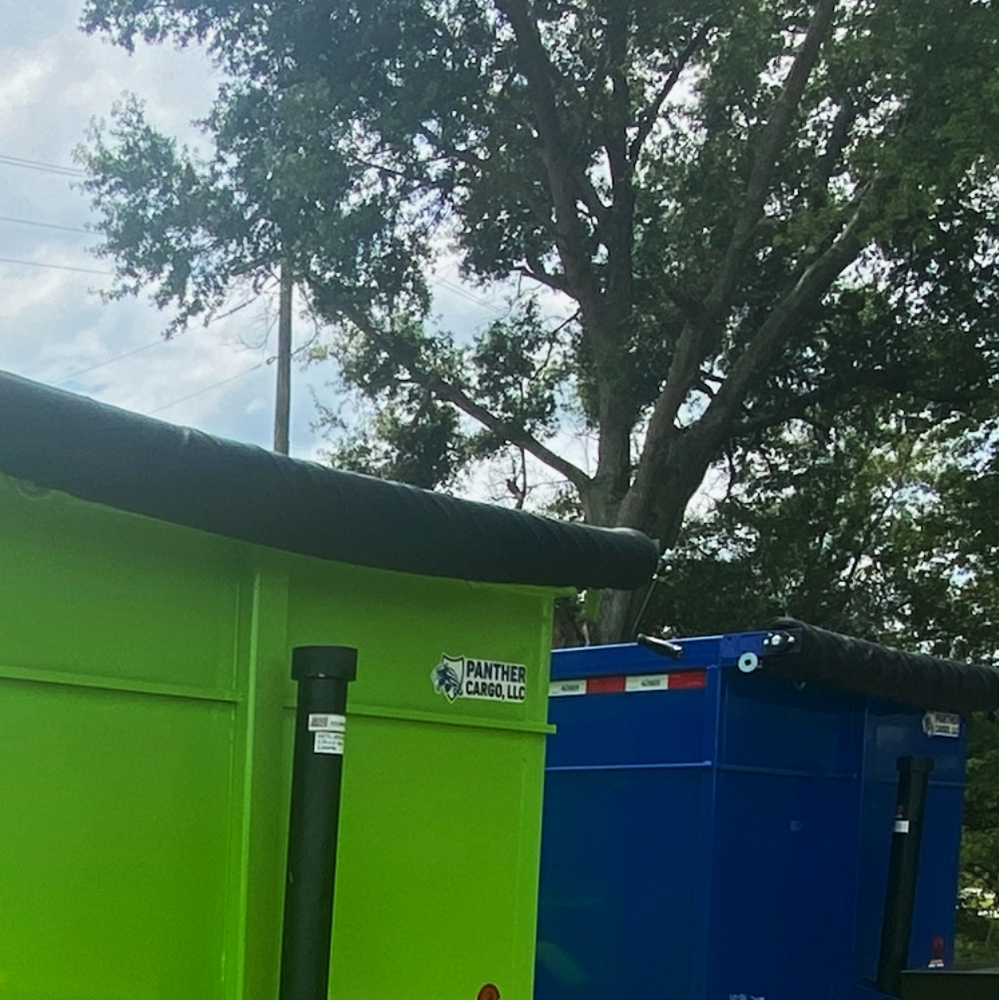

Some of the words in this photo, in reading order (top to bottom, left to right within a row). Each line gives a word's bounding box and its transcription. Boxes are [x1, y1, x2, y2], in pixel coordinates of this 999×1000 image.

[466, 660, 527, 684] PANTHER
[465, 680, 505, 700] CARGO,
[507, 684, 526, 700] LLC
